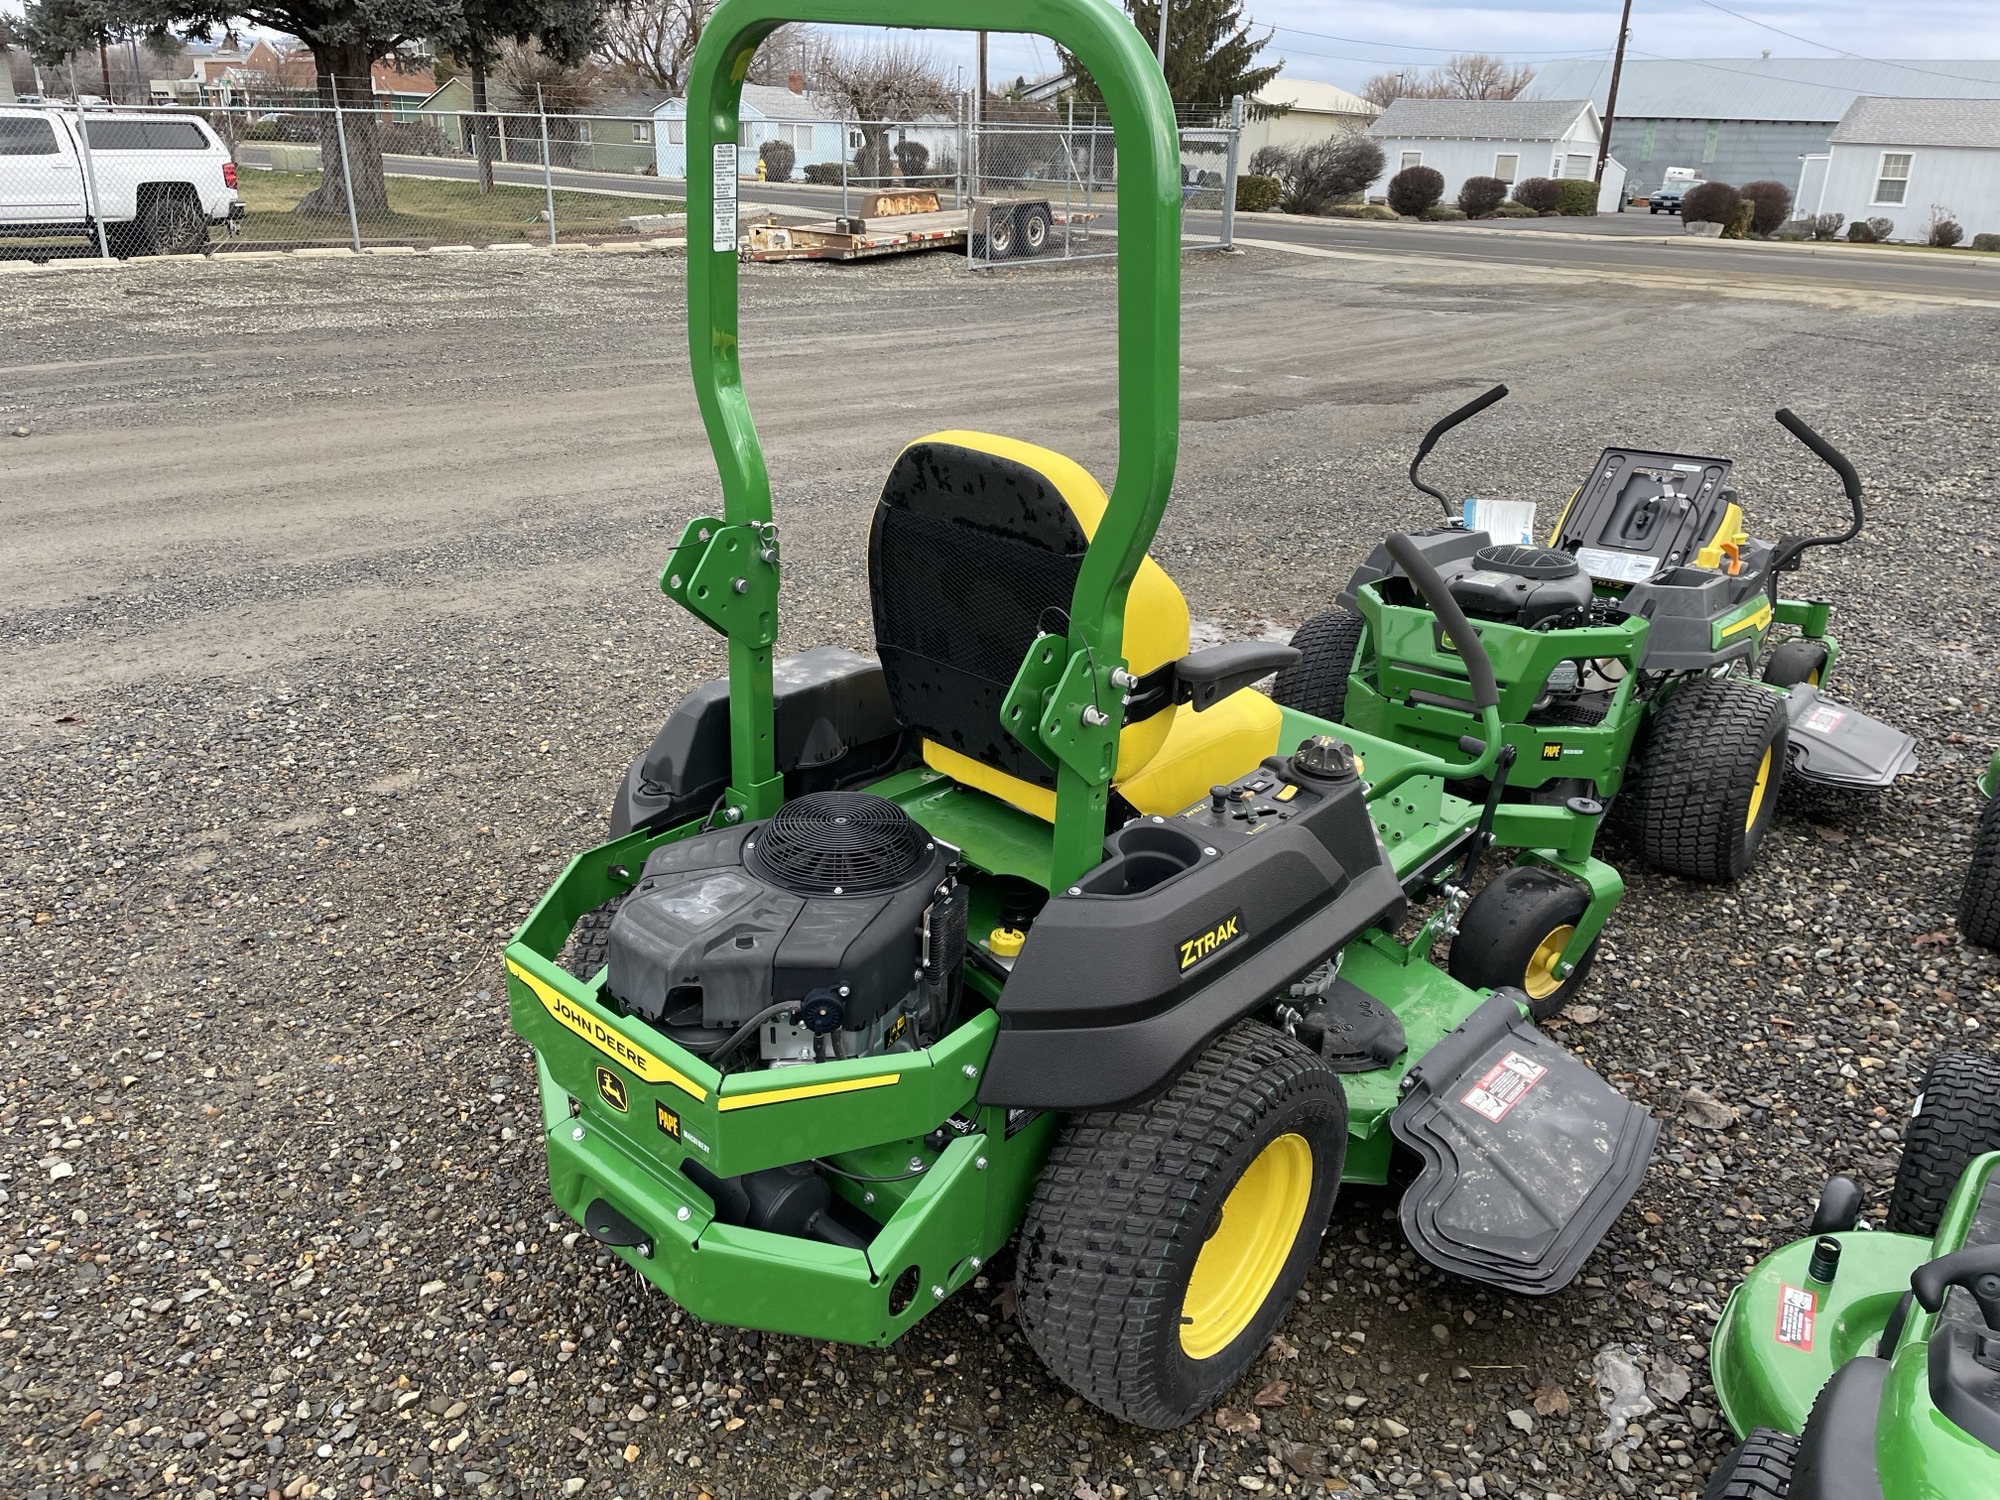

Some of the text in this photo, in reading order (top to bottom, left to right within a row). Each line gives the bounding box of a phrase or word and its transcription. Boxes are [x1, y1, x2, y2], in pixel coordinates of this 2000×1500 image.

[1591, 578, 1625, 590] ZTRA
[1180, 915, 1239, 969] ZTRAK
[553, 998, 647, 1072] JOHN DEERE
